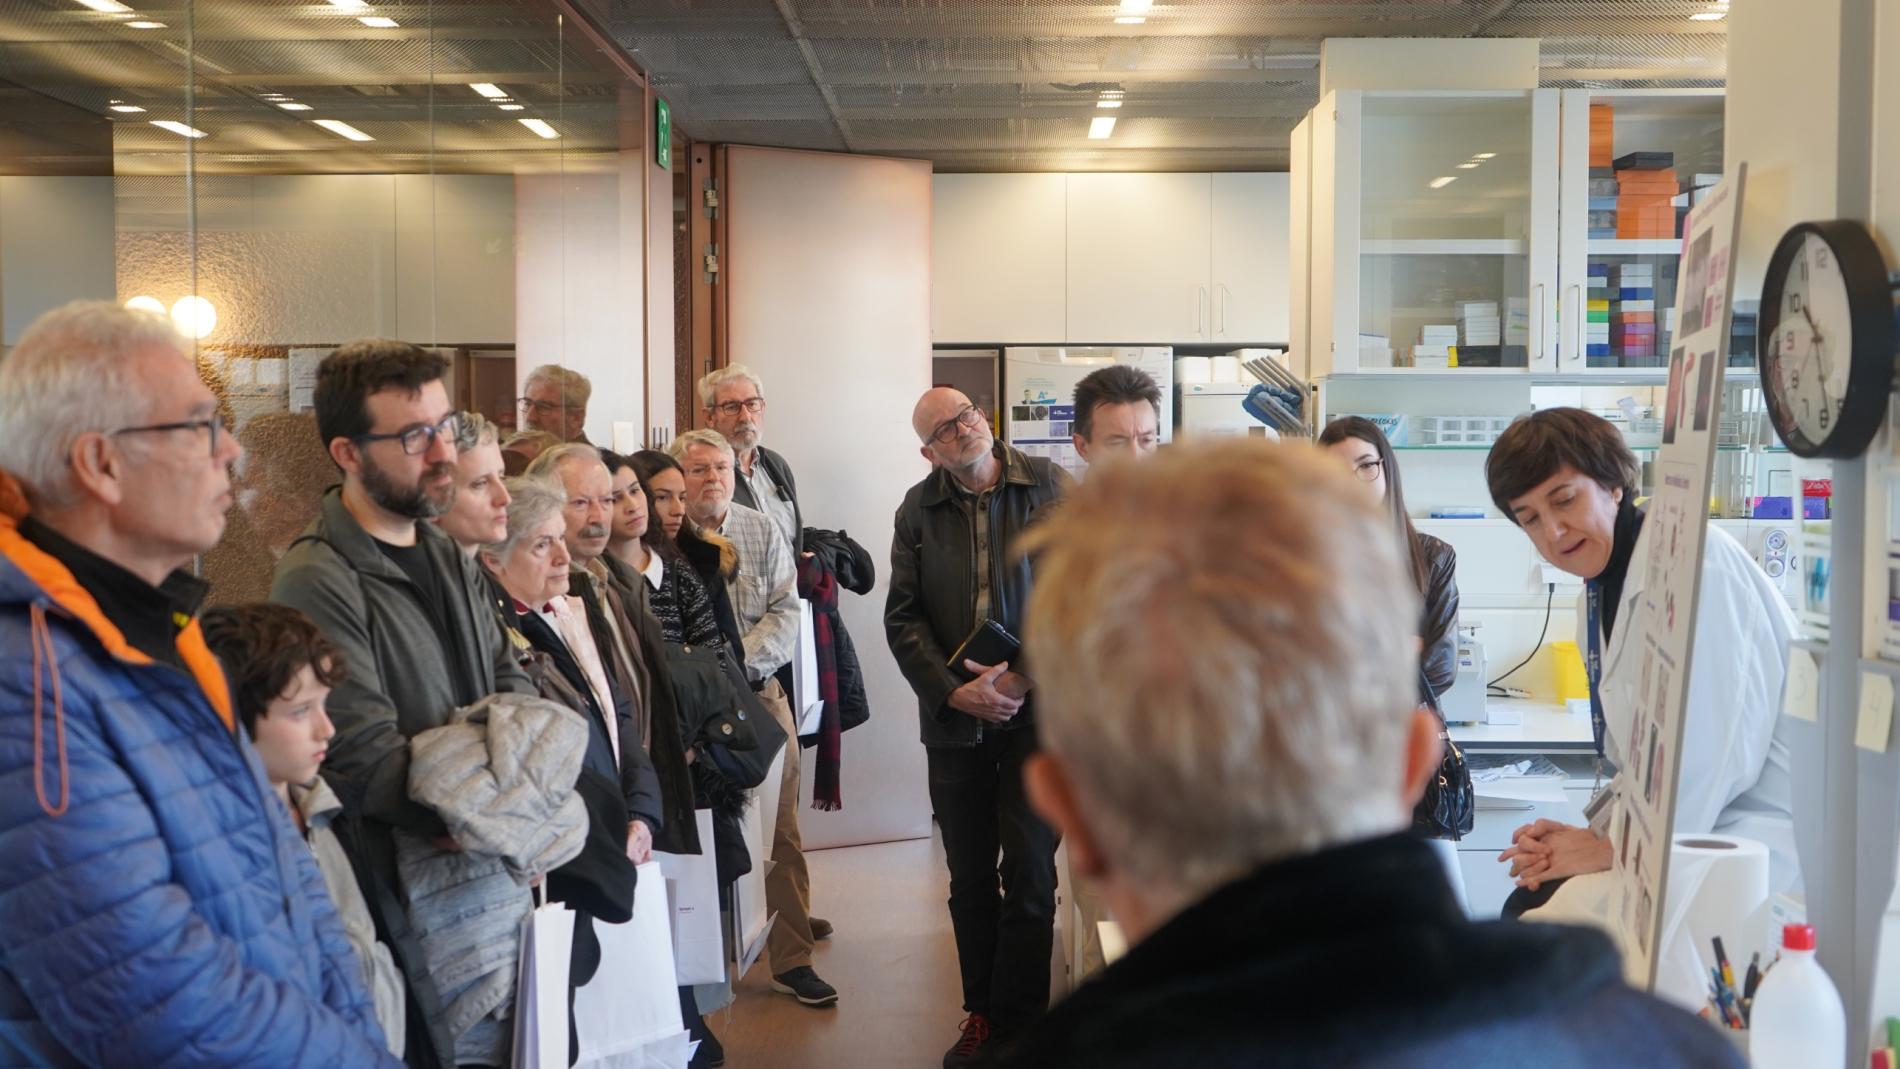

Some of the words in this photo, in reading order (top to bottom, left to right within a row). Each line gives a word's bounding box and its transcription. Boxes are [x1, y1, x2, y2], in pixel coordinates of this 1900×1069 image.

[1816, 247, 1828, 268] 12
[1800, 262, 1809, 281] 11
[1789, 293, 1801, 313] 10
[1786, 331, 1795, 350] 9
[1791, 369, 1799, 389] 8
[1801, 398, 1810, 418] 7
[1819, 408, 1830, 429] 6
